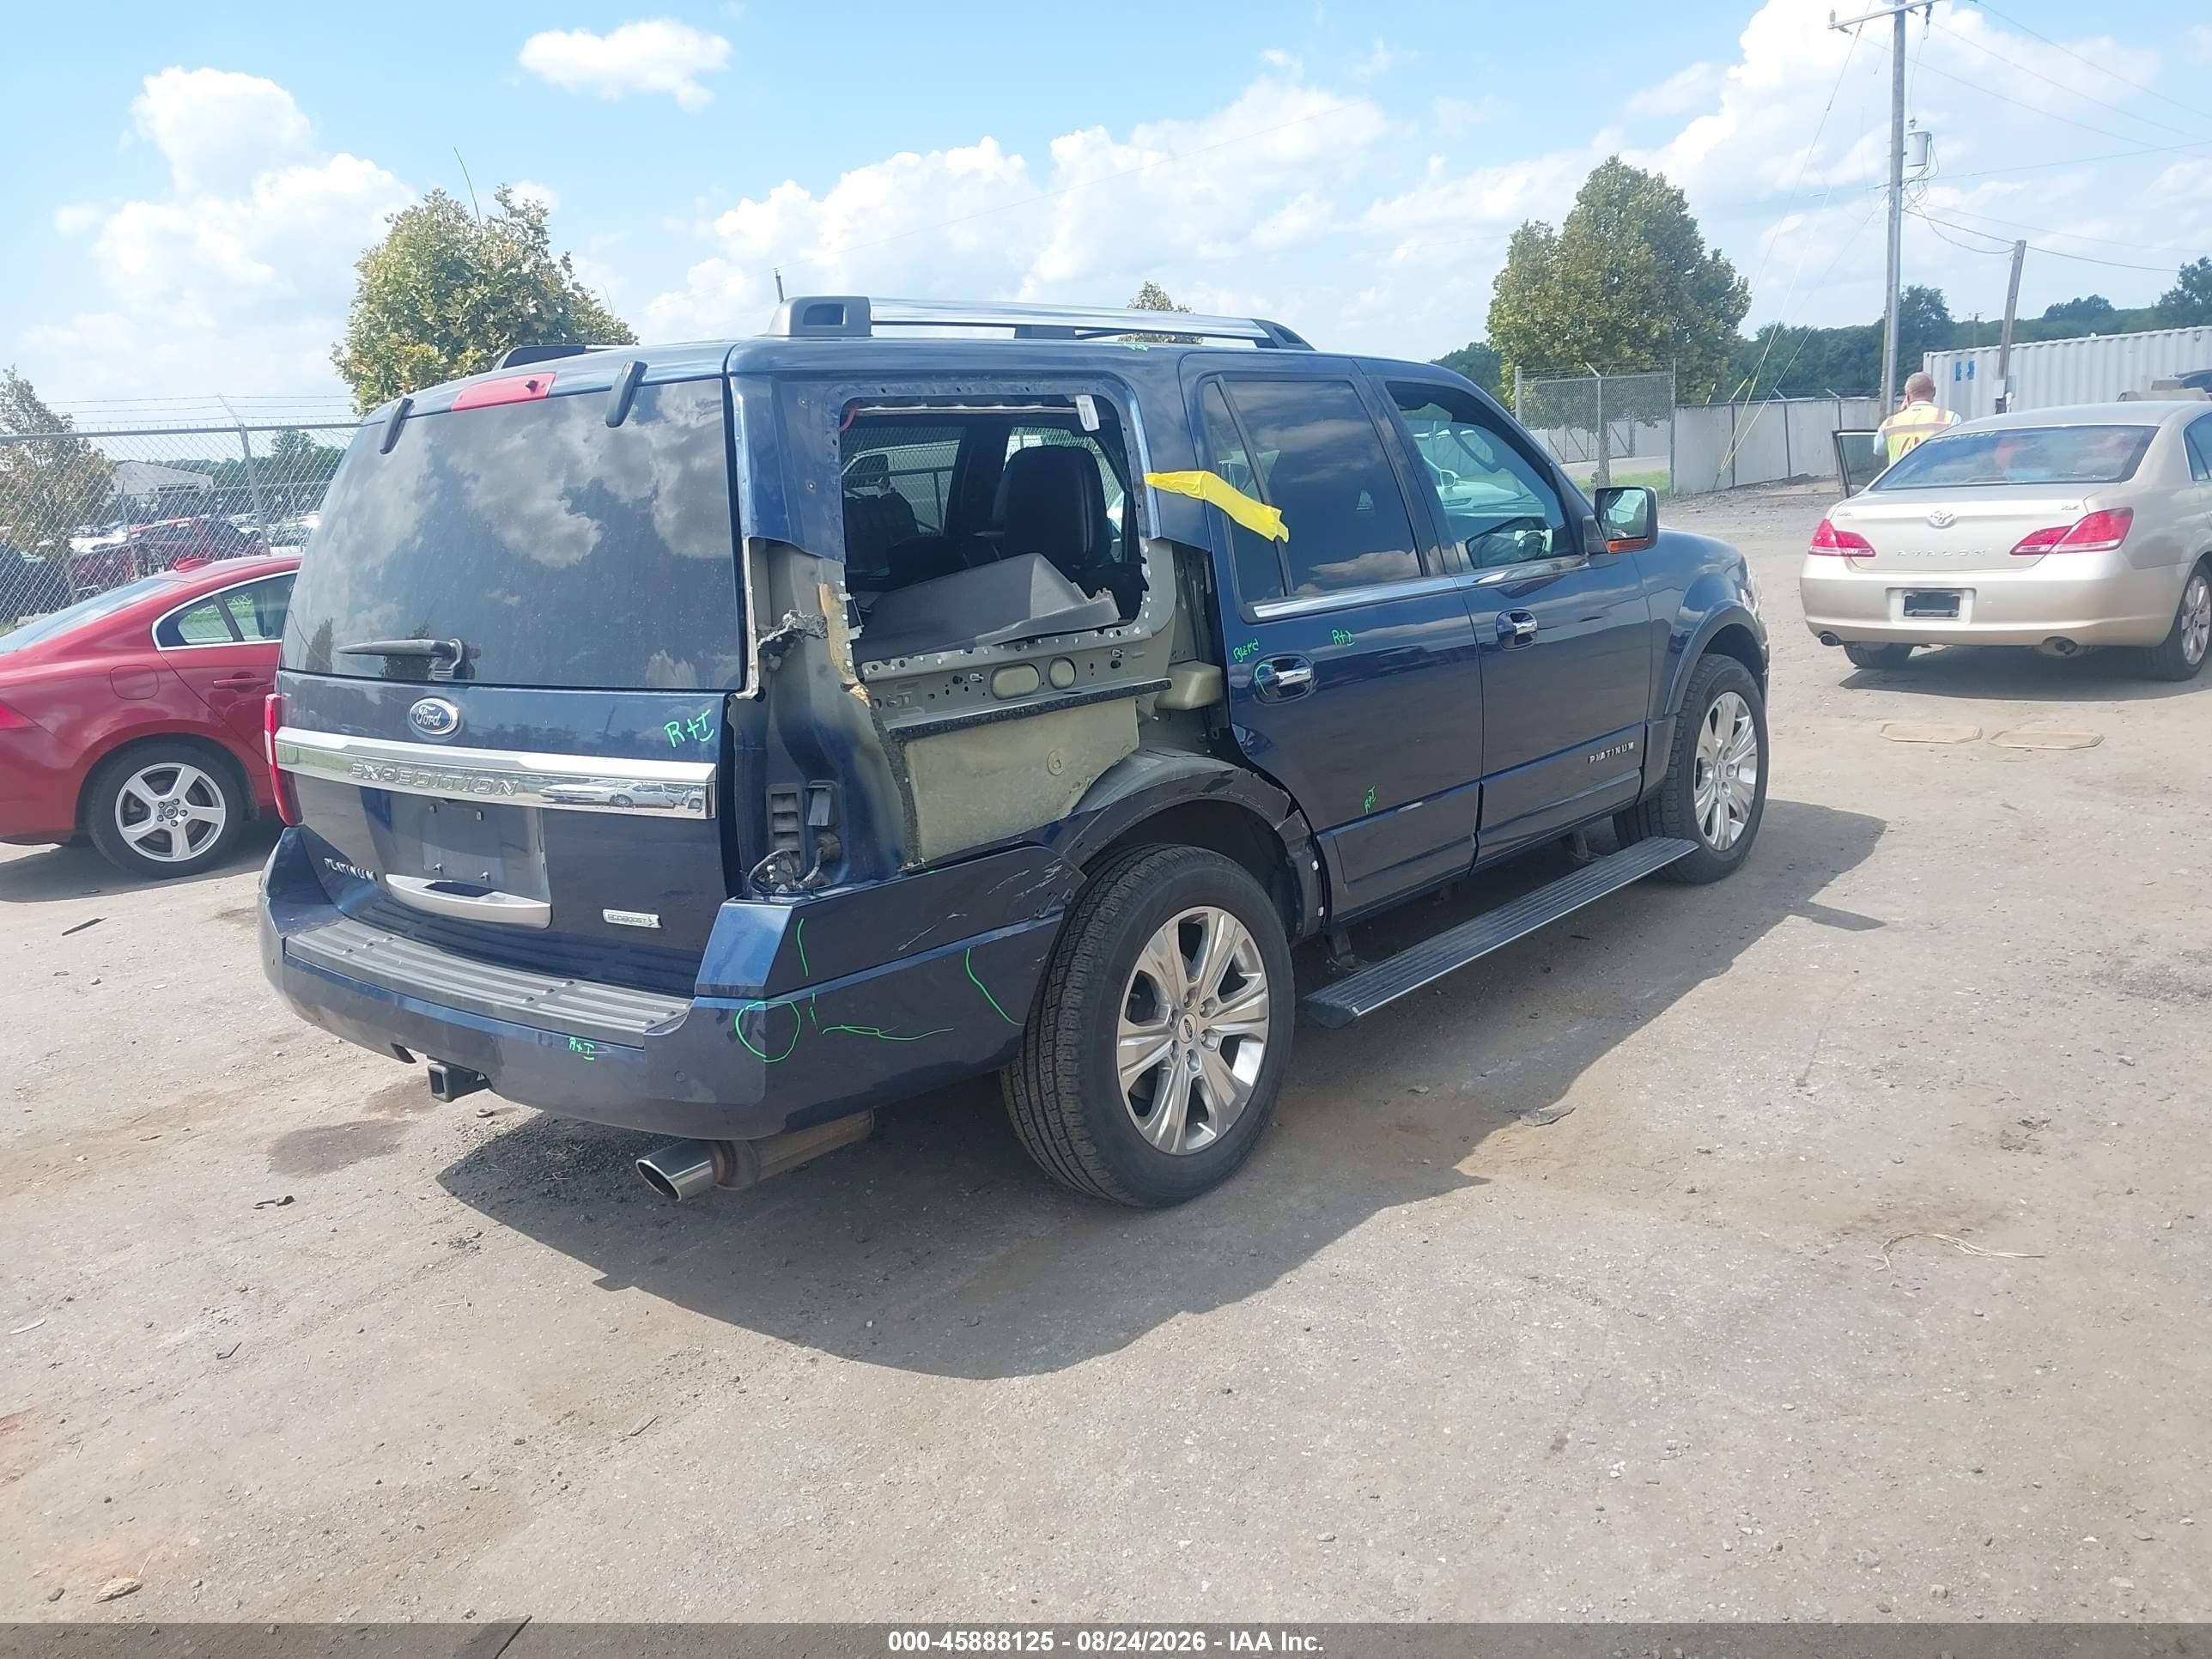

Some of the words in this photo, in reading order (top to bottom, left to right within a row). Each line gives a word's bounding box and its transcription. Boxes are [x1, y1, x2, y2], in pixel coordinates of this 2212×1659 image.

[1588, 741, 1635, 763] PLATINUM
[349, 762, 520, 798] EXPEDITION
[323, 857, 378, 882] PLATINUM
